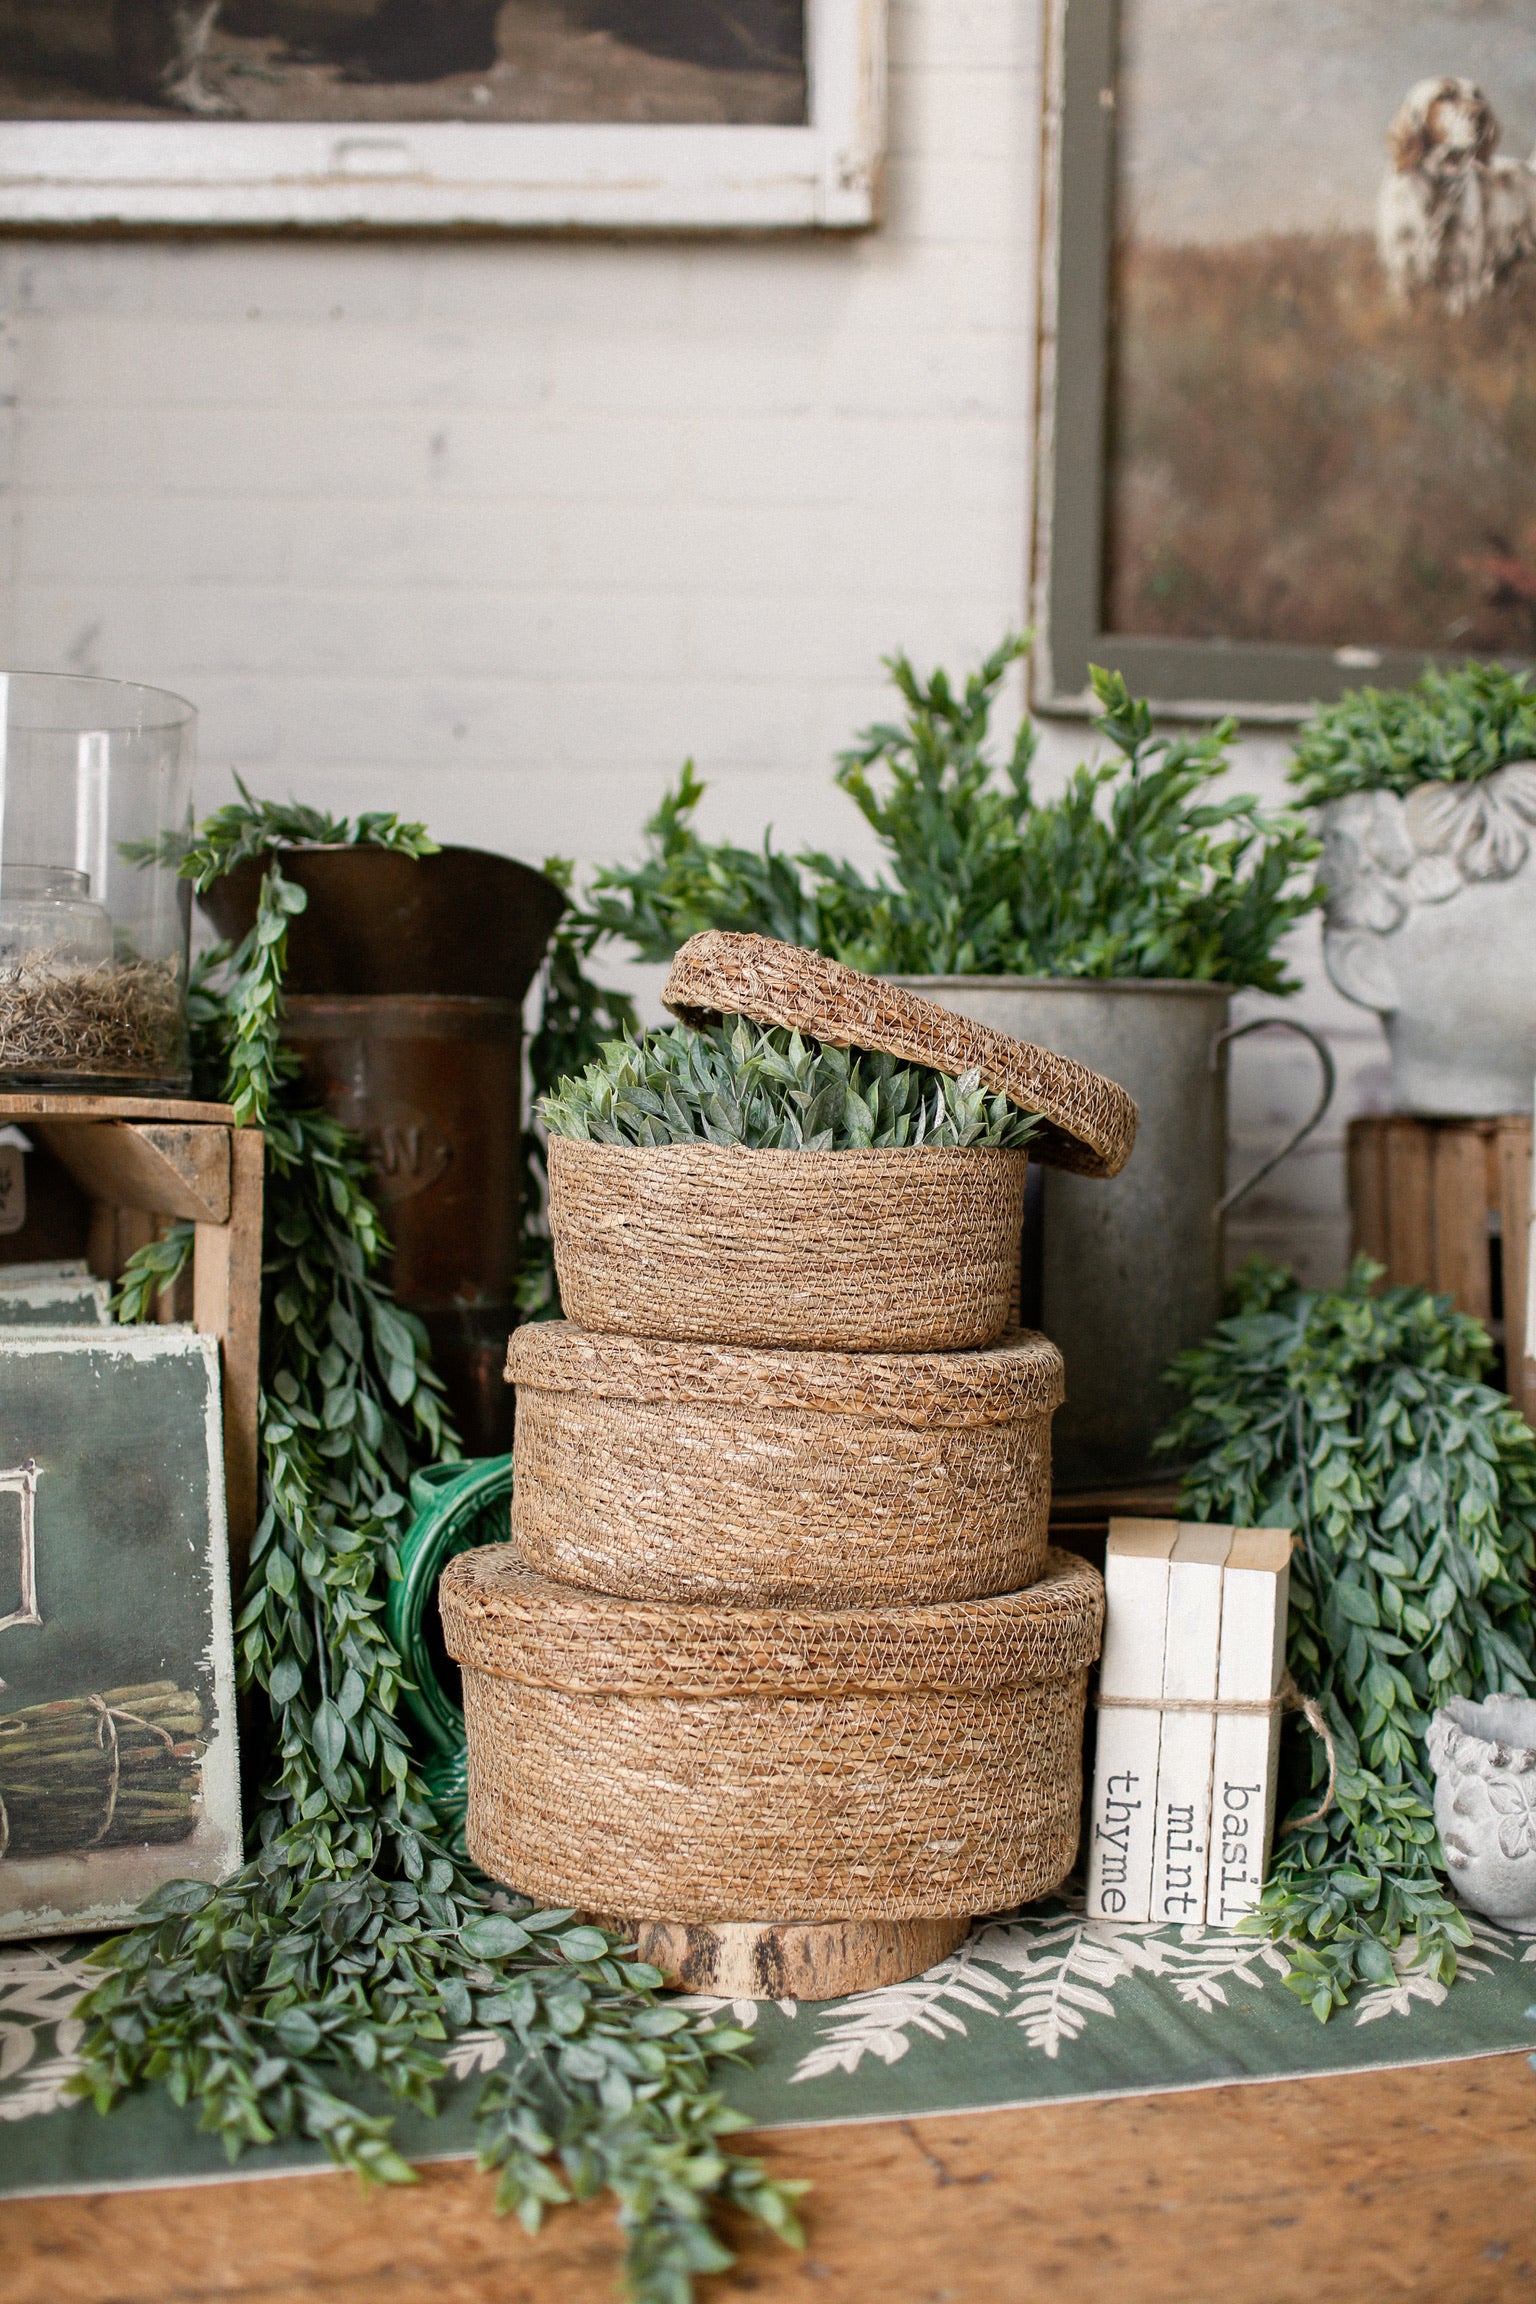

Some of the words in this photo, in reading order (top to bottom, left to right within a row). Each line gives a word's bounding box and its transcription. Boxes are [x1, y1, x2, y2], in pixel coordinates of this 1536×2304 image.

[1095, 1770, 1142, 1914] thyme
[1164, 1803, 1203, 1915] mint
[1220, 1781, 1261, 1921] basil
